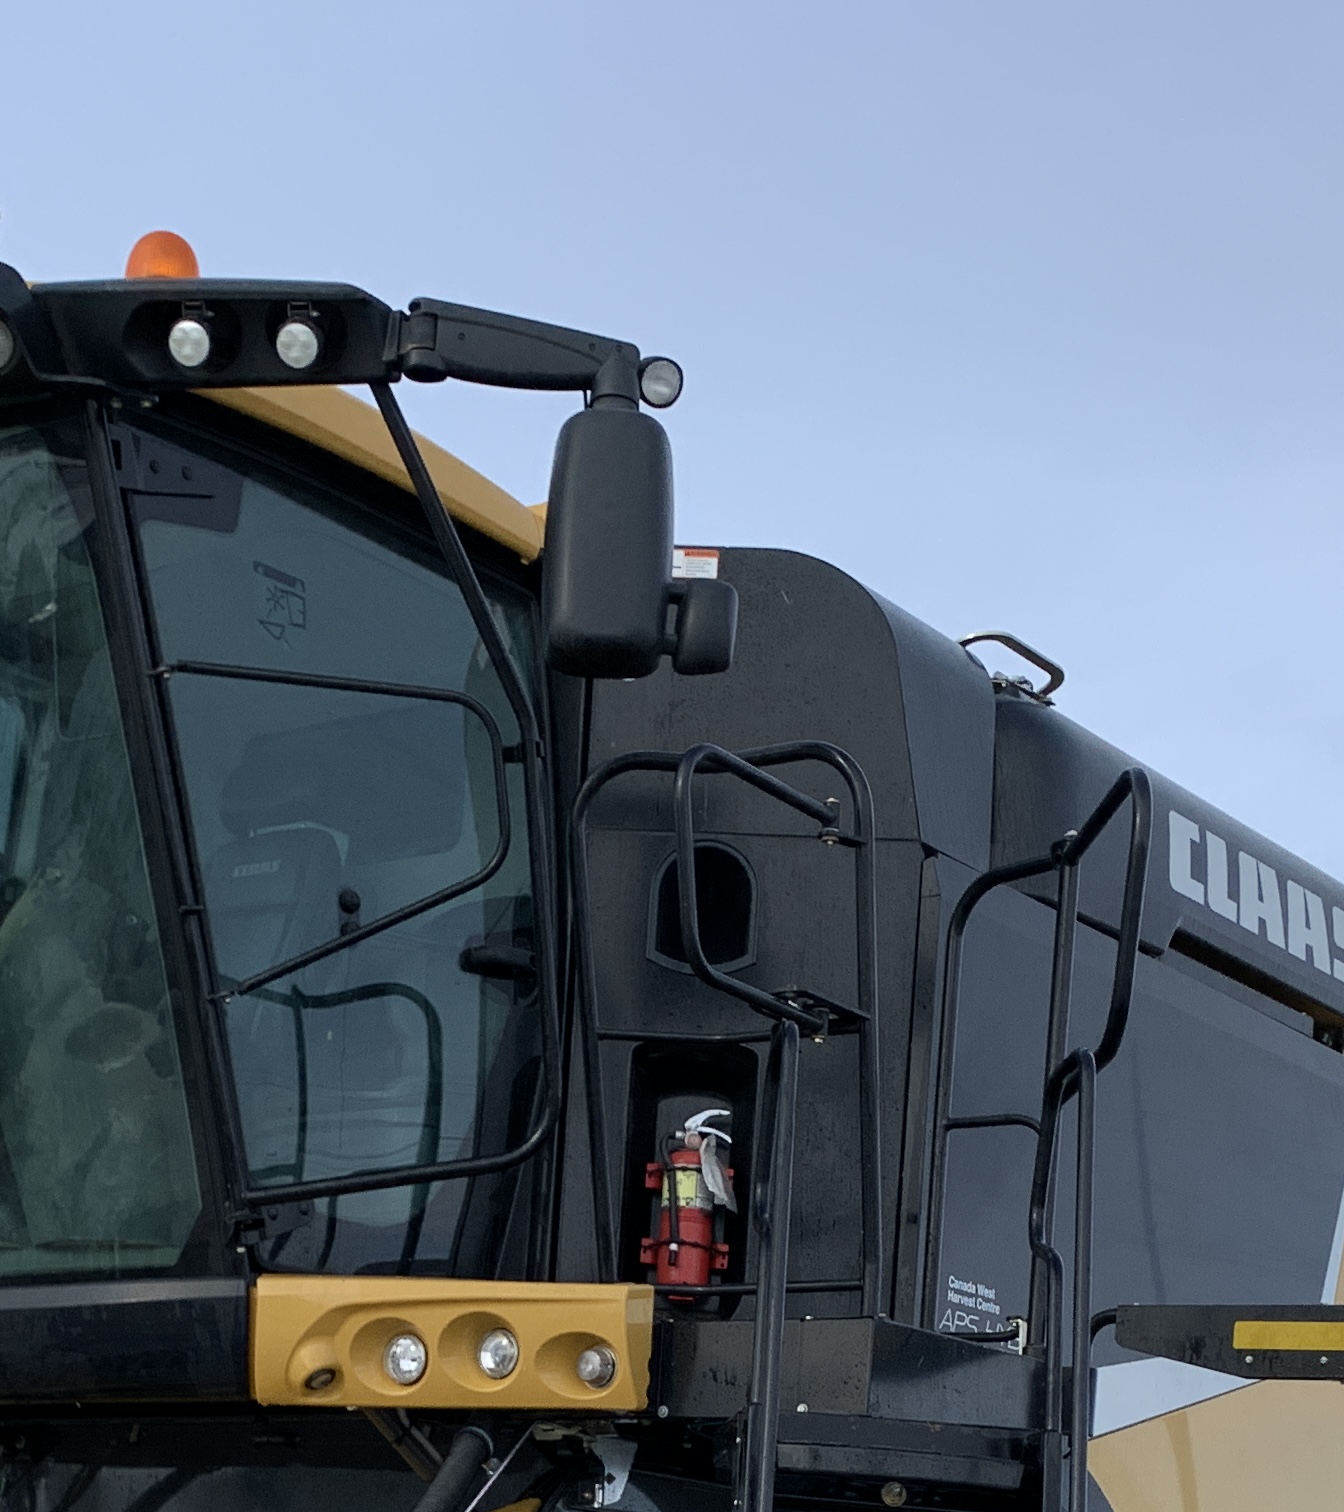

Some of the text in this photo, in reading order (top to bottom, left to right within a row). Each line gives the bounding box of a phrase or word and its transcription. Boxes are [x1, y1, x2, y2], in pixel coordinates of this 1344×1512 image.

[948, 1275, 996, 1300] Canada West
[947, 1290, 1001, 1315] Harvest Centre
